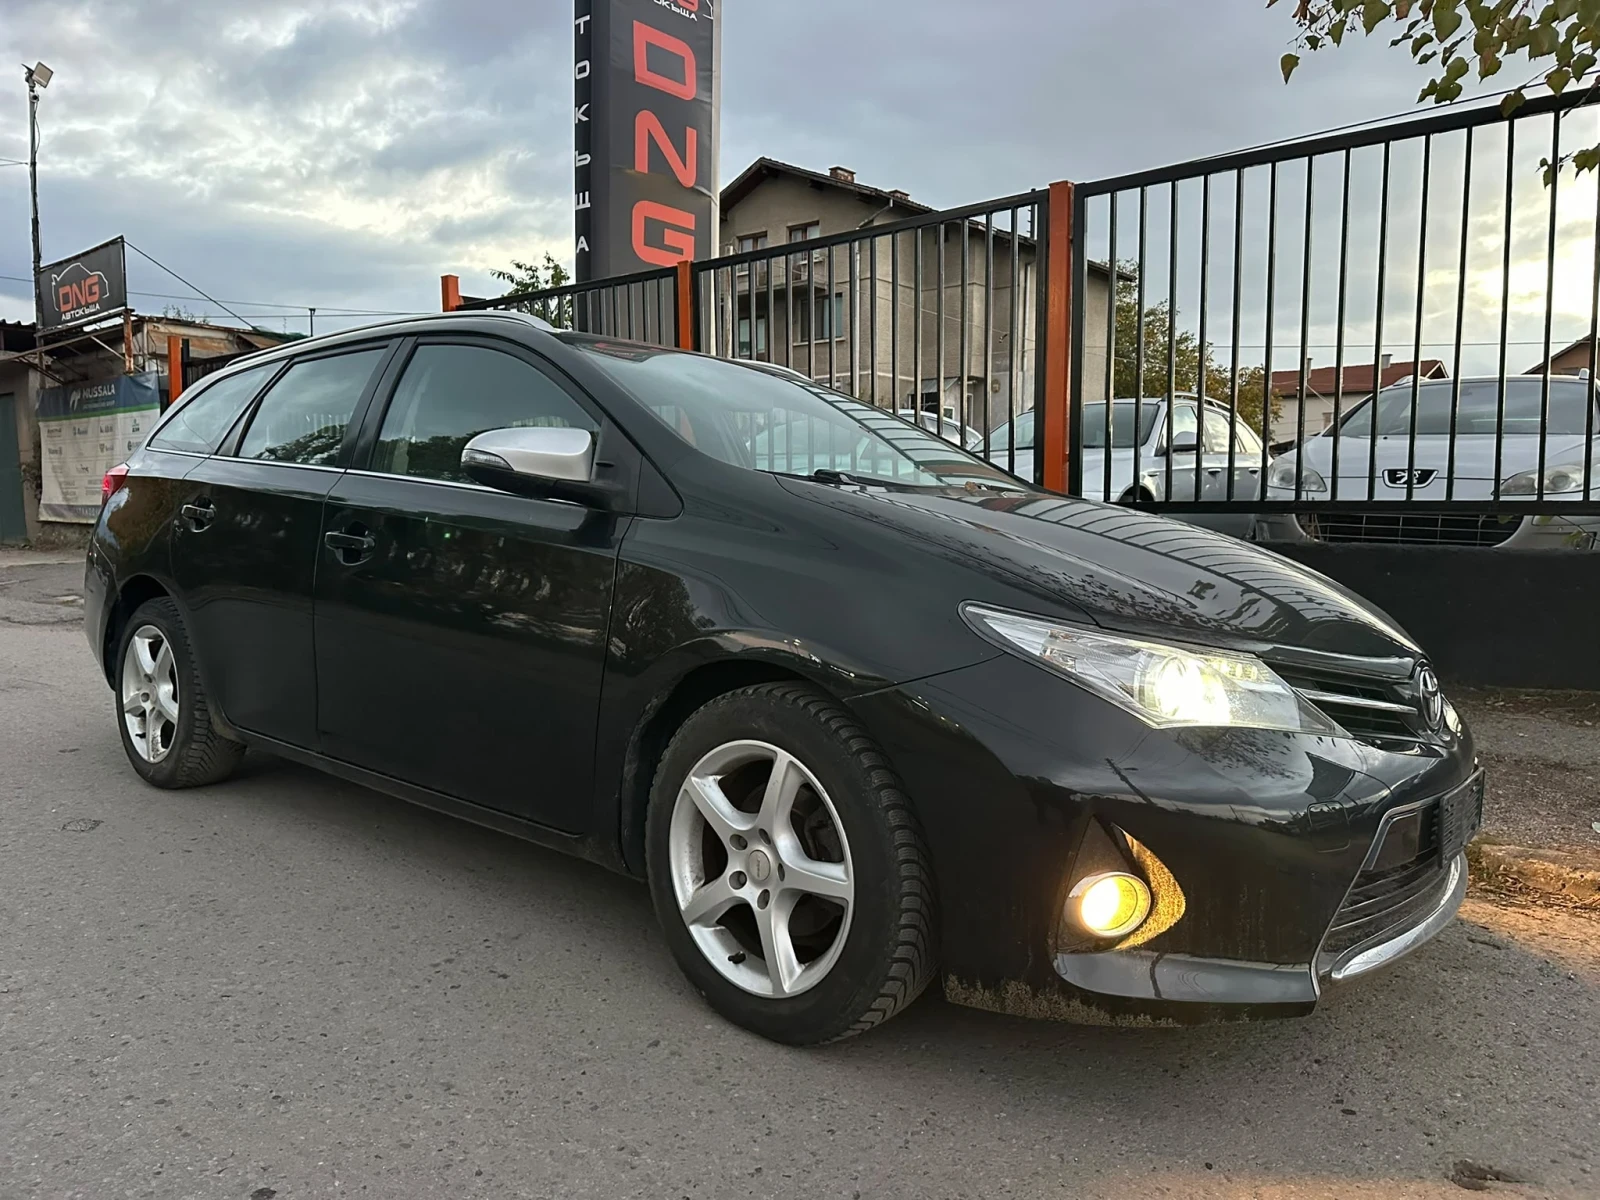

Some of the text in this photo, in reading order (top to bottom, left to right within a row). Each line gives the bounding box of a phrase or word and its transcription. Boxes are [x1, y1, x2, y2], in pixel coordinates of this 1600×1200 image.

[632, 19, 697, 268] DNG
[59, 275, 100, 312] DNG
[82, 384, 115, 399] MUSSALA
